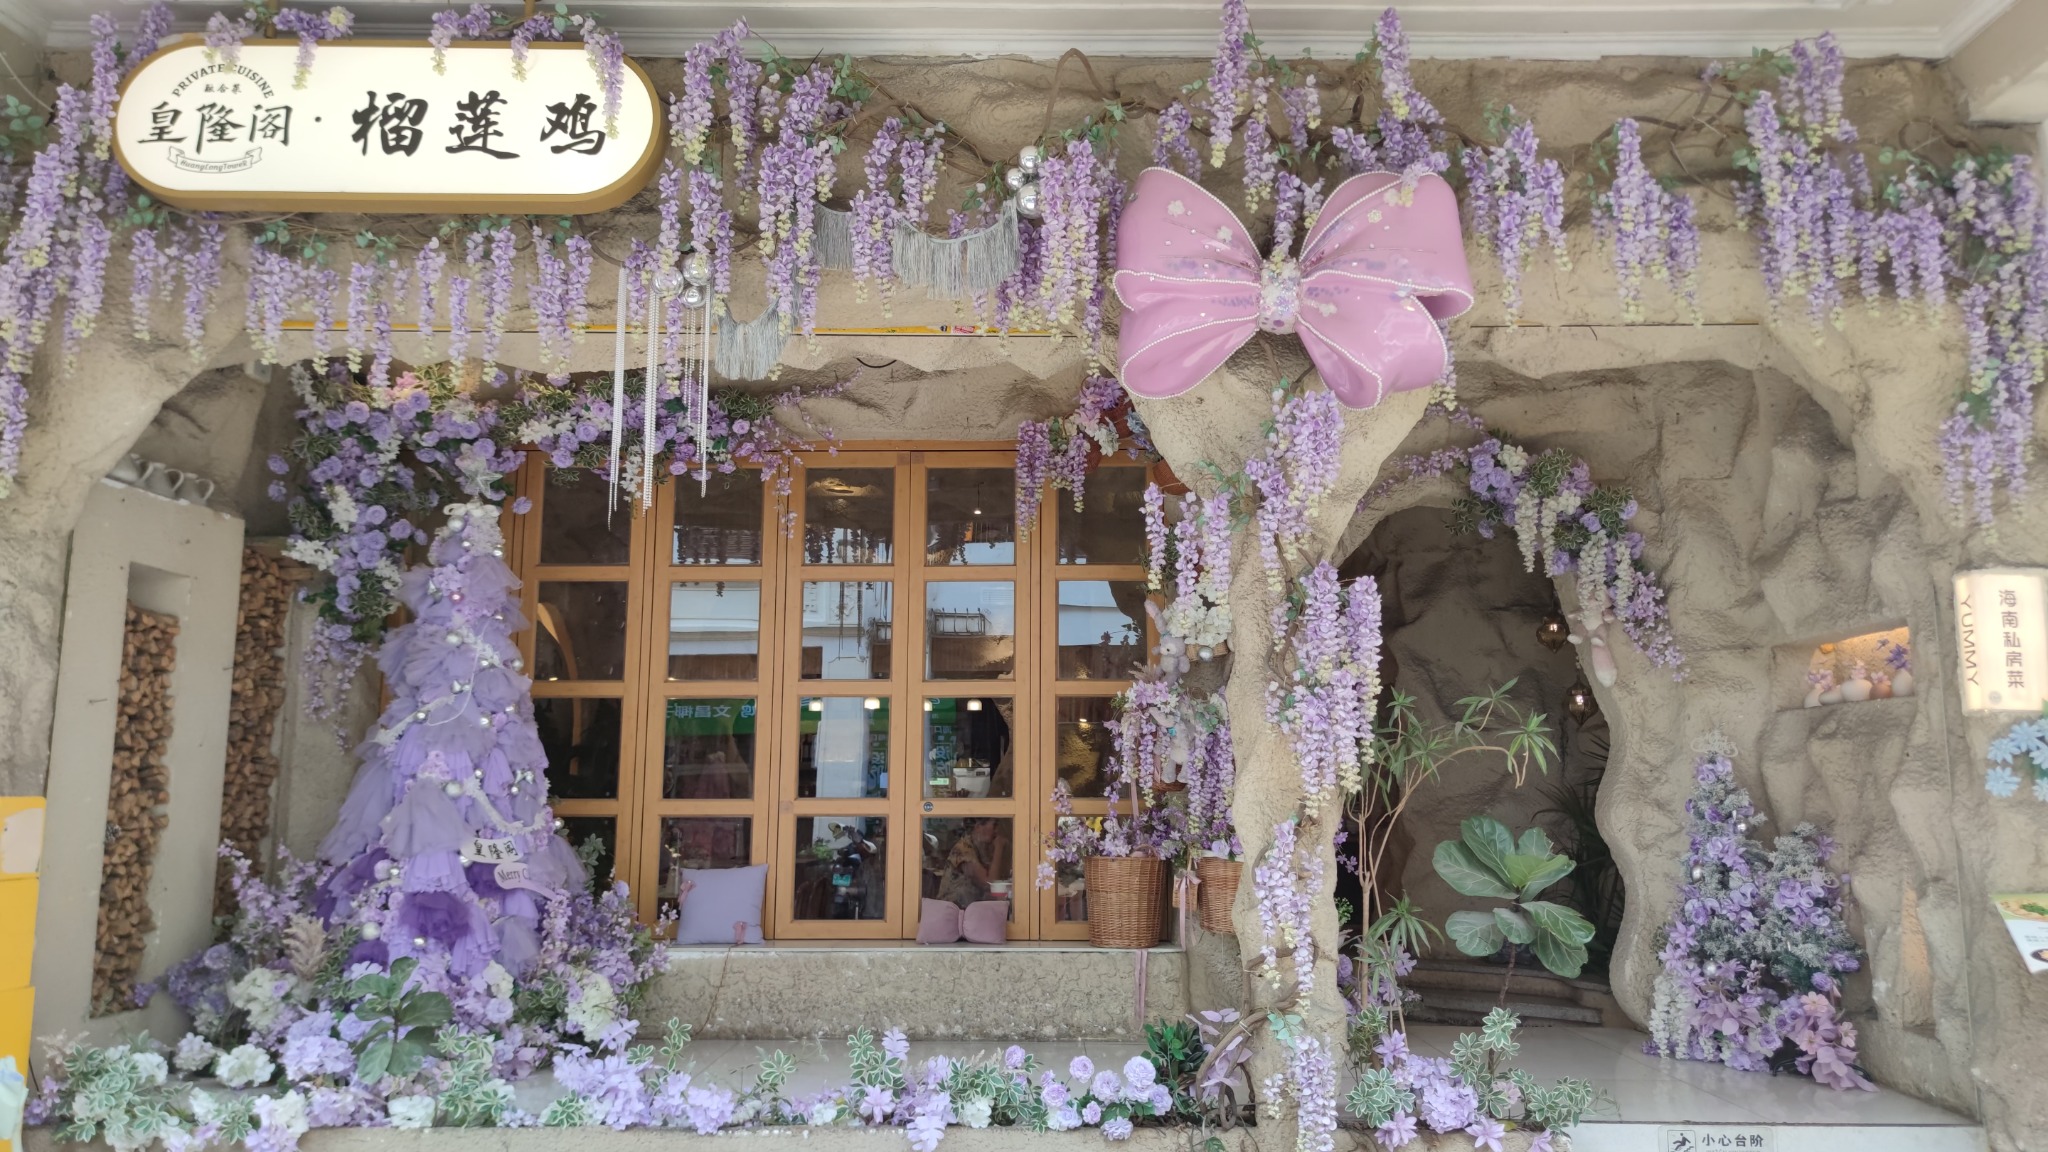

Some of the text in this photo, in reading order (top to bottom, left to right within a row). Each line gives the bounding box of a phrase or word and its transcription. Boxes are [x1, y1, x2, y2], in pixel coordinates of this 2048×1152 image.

[136, 100, 293, 155] 皇隆阁
[351, 90, 606, 160] 榴莲鸡
[1960, 594, 1980, 687] YUMMY
[1997, 589, 2025, 689] 海南私房菜
[497, 869, 522, 883] Merry
[1702, 1133, 1764, 1148] 小心台阶
